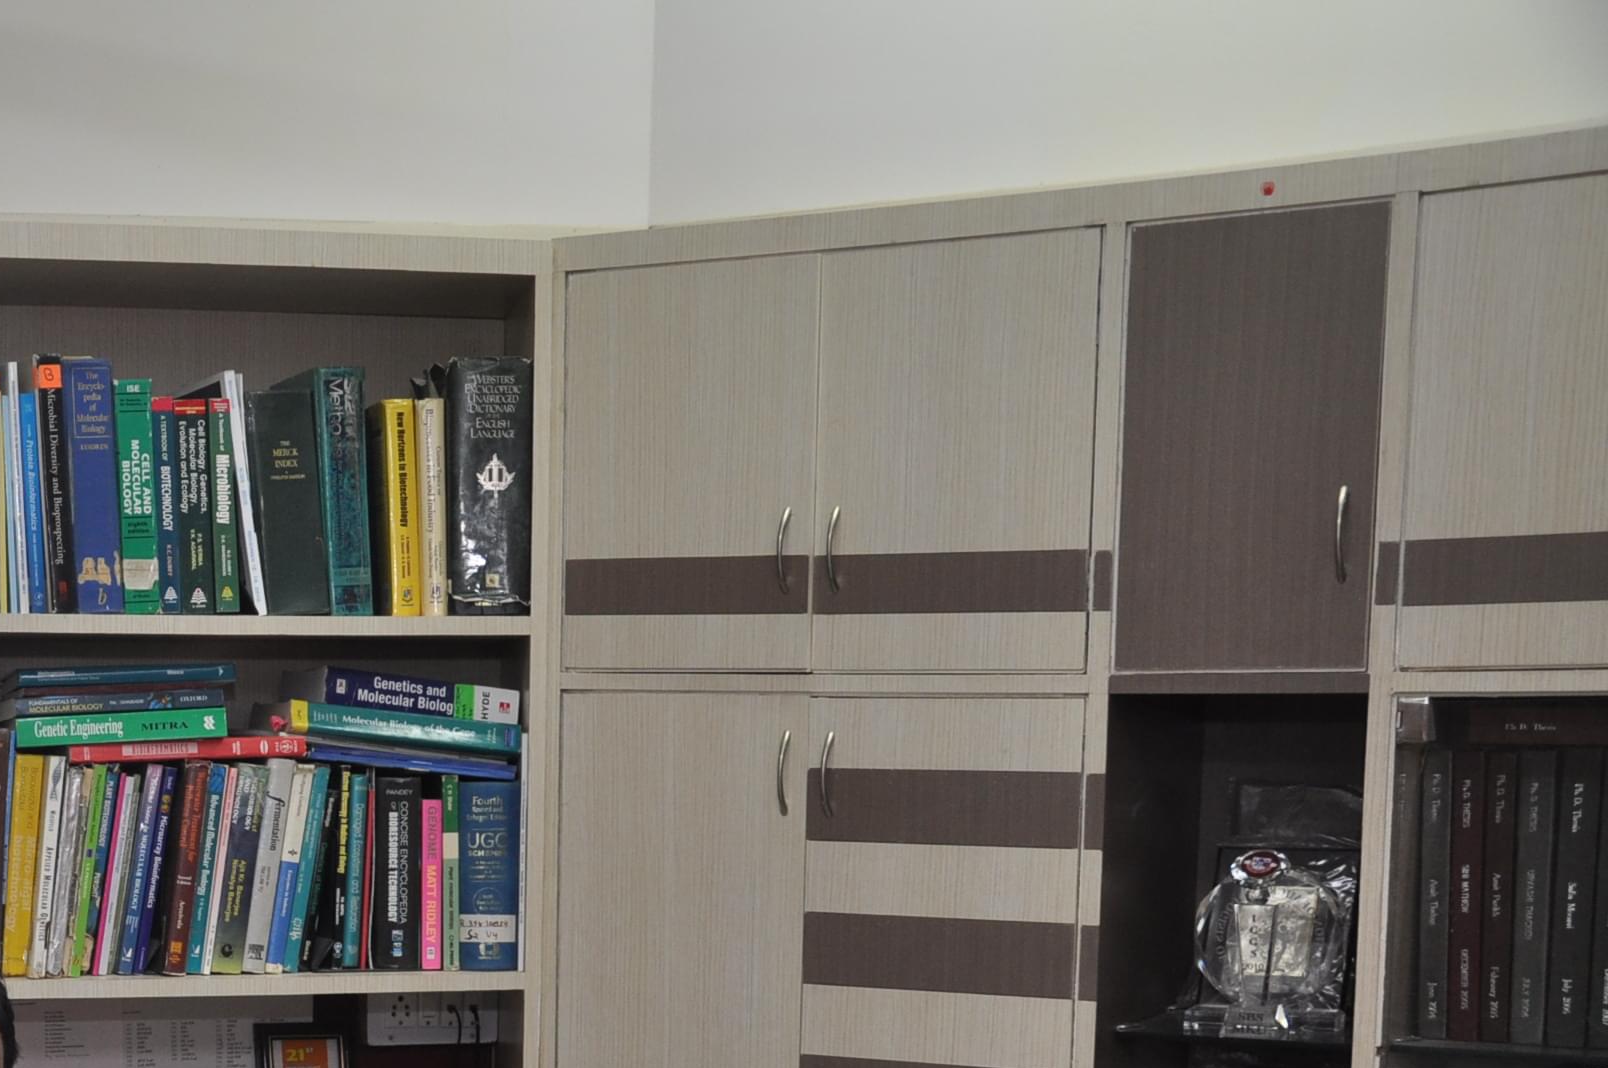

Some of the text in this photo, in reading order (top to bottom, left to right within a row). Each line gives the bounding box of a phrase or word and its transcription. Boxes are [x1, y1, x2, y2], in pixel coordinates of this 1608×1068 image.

[86, 371, 99, 380] The
[126, 384, 141, 393] ISE
[464, 383, 521, 394] ENCYCLOPEDIC
[83, 391, 102, 403] pedia
[89, 402, 97, 412] of
[466, 393, 520, 404] UNABRIDGED
[466, 403, 516, 414] DICTIONARY
[76, 412, 108, 423] Molecular
[80, 423, 106, 434] Biology
[396, 412, 405, 428] New
[475, 416, 511, 429] ENGLISH
[160, 421, 168, 450] TEXTBOOK
[396, 429, 406, 462] Horizons
[470, 427, 515, 439] LANGUAGE
[161, 452, 169, 461] OF
[188, 428, 198, 471] Molecular
[45, 387, 66, 566] Microbial Diversity and Bioprospecting
[130, 439, 142, 515] MOLECULAR
[178, 421, 190, 515] Evolution and Ecology
[196, 419, 209, 515] Cell Biology, Genetics,
[26, 439, 38, 531] Protein Bioinformatics
[121, 460, 133, 516] BIOLOGY
[140, 453, 152, 515] CELL AND
[160, 465, 174, 532] BIOTECHNOLOGY
[215, 454, 231, 525] Microbiology
[426, 474, 436, 500] Food
[398, 472, 409, 528] Biotechnology
[180, 695, 208, 703] OXFORD
[357, 687, 415, 708] Molecular
[373, 675, 446, 698] Genetics and
[28, 702, 104, 713] MOLECULAR BIOLOGY
[480, 690, 491, 720] HYDE
[34, 717, 189, 740] Genetic Engineering MITRA
[342, 714, 388, 728] Molecular
[424, 722, 435, 732] of
[97, 780, 115, 848] PLANT BIOTECHNOLOGY
[472, 795, 504, 806] Fourth
[265, 790, 287, 852] fermentation
[197, 794, 221, 897] Advanced Molecular Biology
[388, 811, 400, 870] BIORESOURCE
[467, 832, 508, 849] UGC
[130, 834, 149, 911] MOLECULAR BIOLOGY
[146, 815, 168, 909] Microarray Bioinformatics
[399, 800, 409, 925] CONCISE ENCYCLOPEDIA
[426, 806, 438, 944] GENOME MATT RIDLEY
[233, 885, 244, 917] Banerjee
[351, 879, 362, 894] and
[387, 870, 399, 922] TECHNOLOGY
[224, 890, 236, 923] Banerjee
[1560, 978, 1574, 993] July
